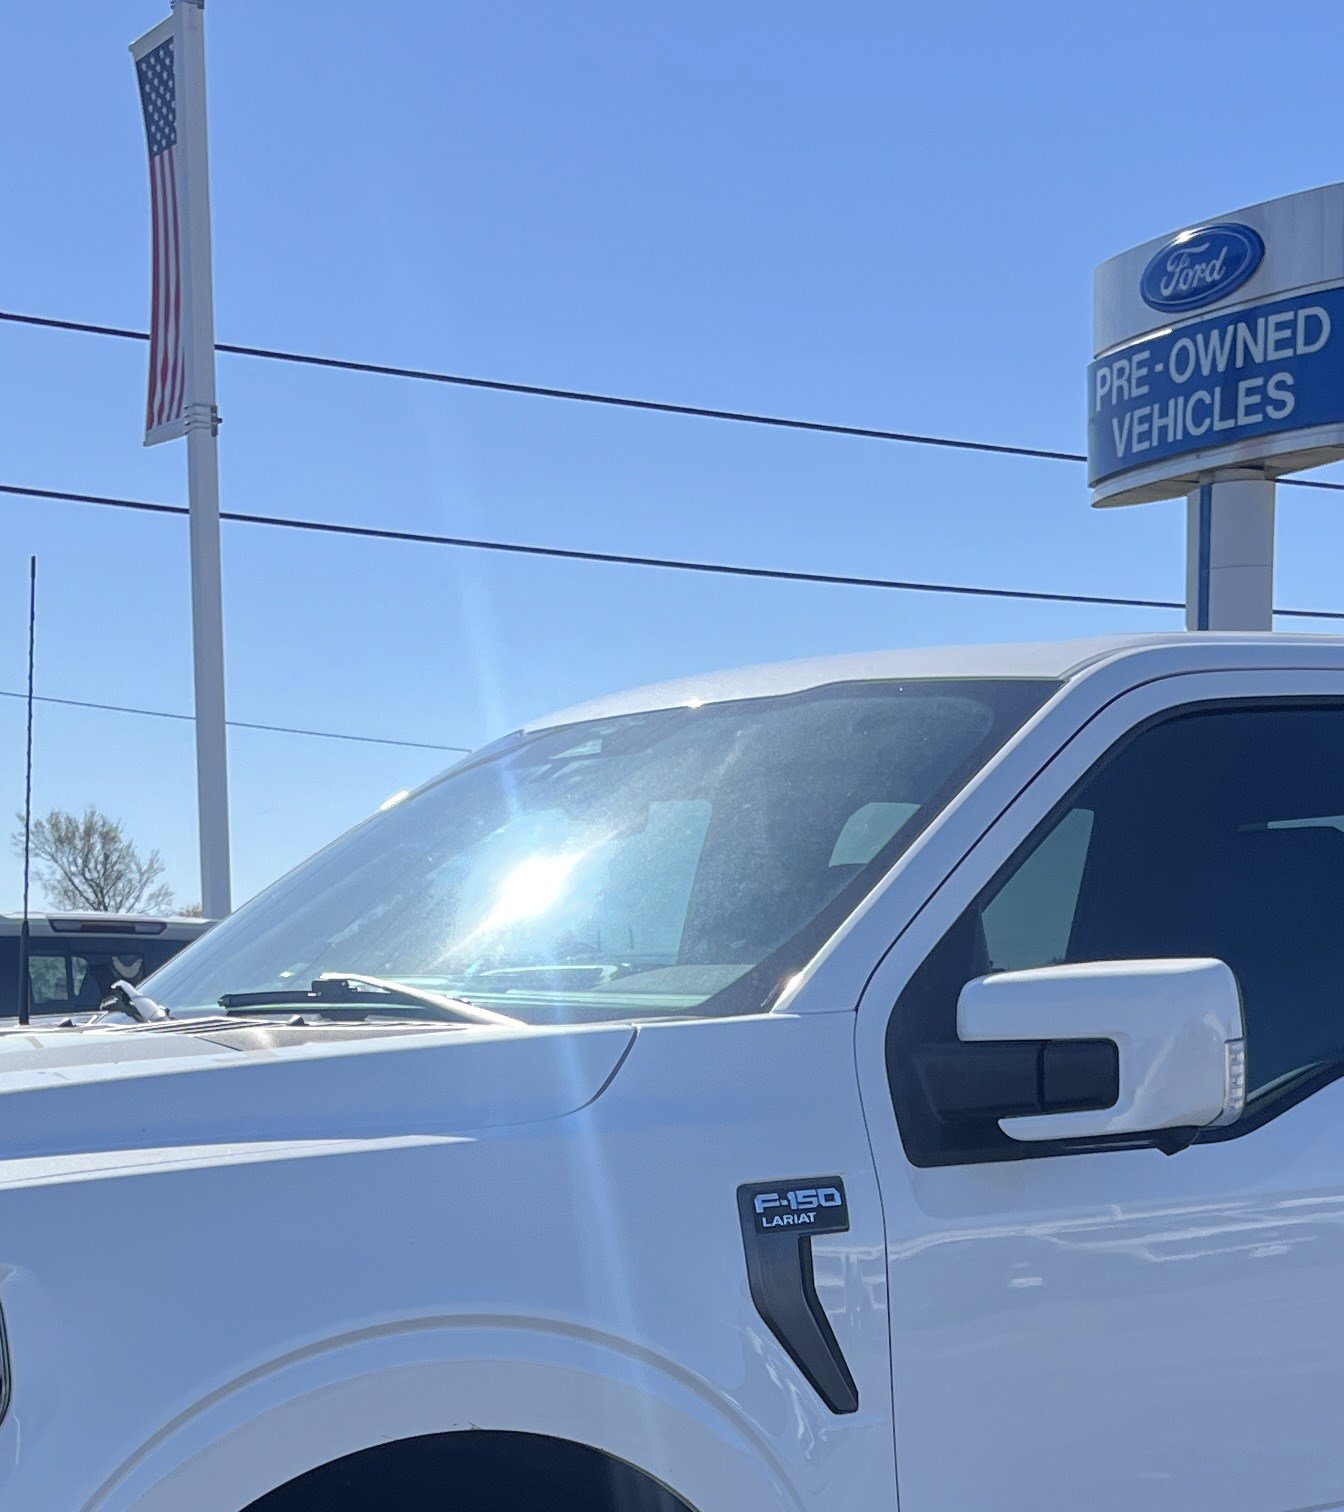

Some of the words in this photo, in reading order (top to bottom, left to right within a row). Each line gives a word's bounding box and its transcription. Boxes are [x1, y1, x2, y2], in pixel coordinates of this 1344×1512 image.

[1160, 242, 1227, 298] Ford
[1110, 371, 1297, 459] VEHICLES
[754, 1187, 843, 1214] F-150
[761, 1211, 817, 1228] LARIAT
